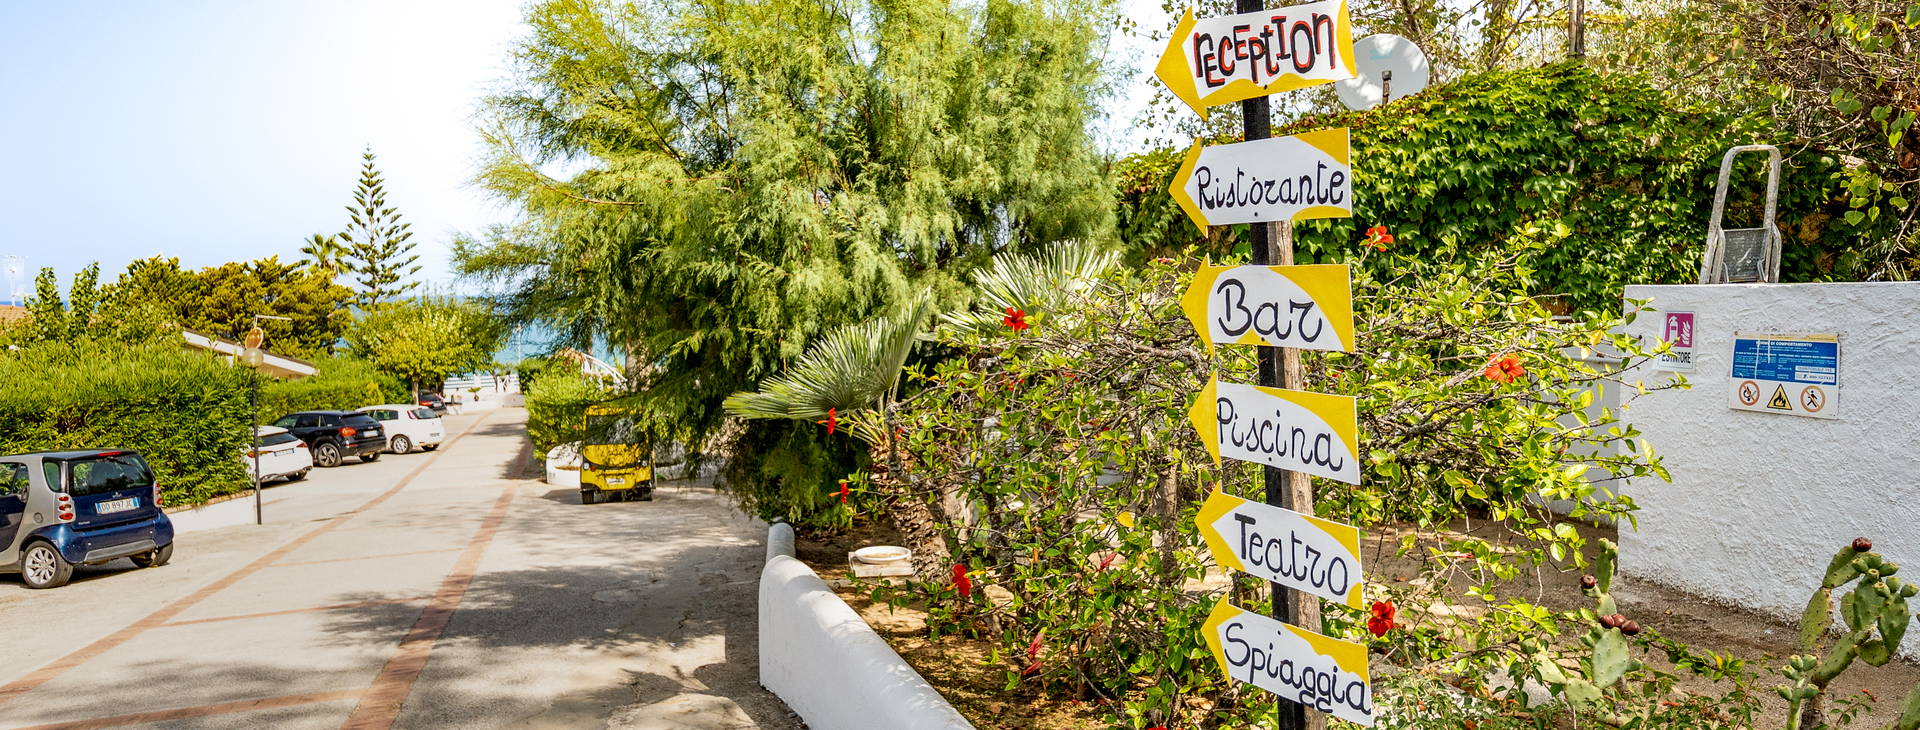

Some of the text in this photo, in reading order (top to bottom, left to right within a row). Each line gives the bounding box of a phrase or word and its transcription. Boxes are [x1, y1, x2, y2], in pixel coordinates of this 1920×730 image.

[1195, 160, 1345, 210] Ristorante
[1216, 278, 1323, 343] Bar
[1216, 396, 1344, 472] Piscina
[1234, 512, 1348, 596] Teatro
[1224, 622, 1372, 716] Spiaggia
